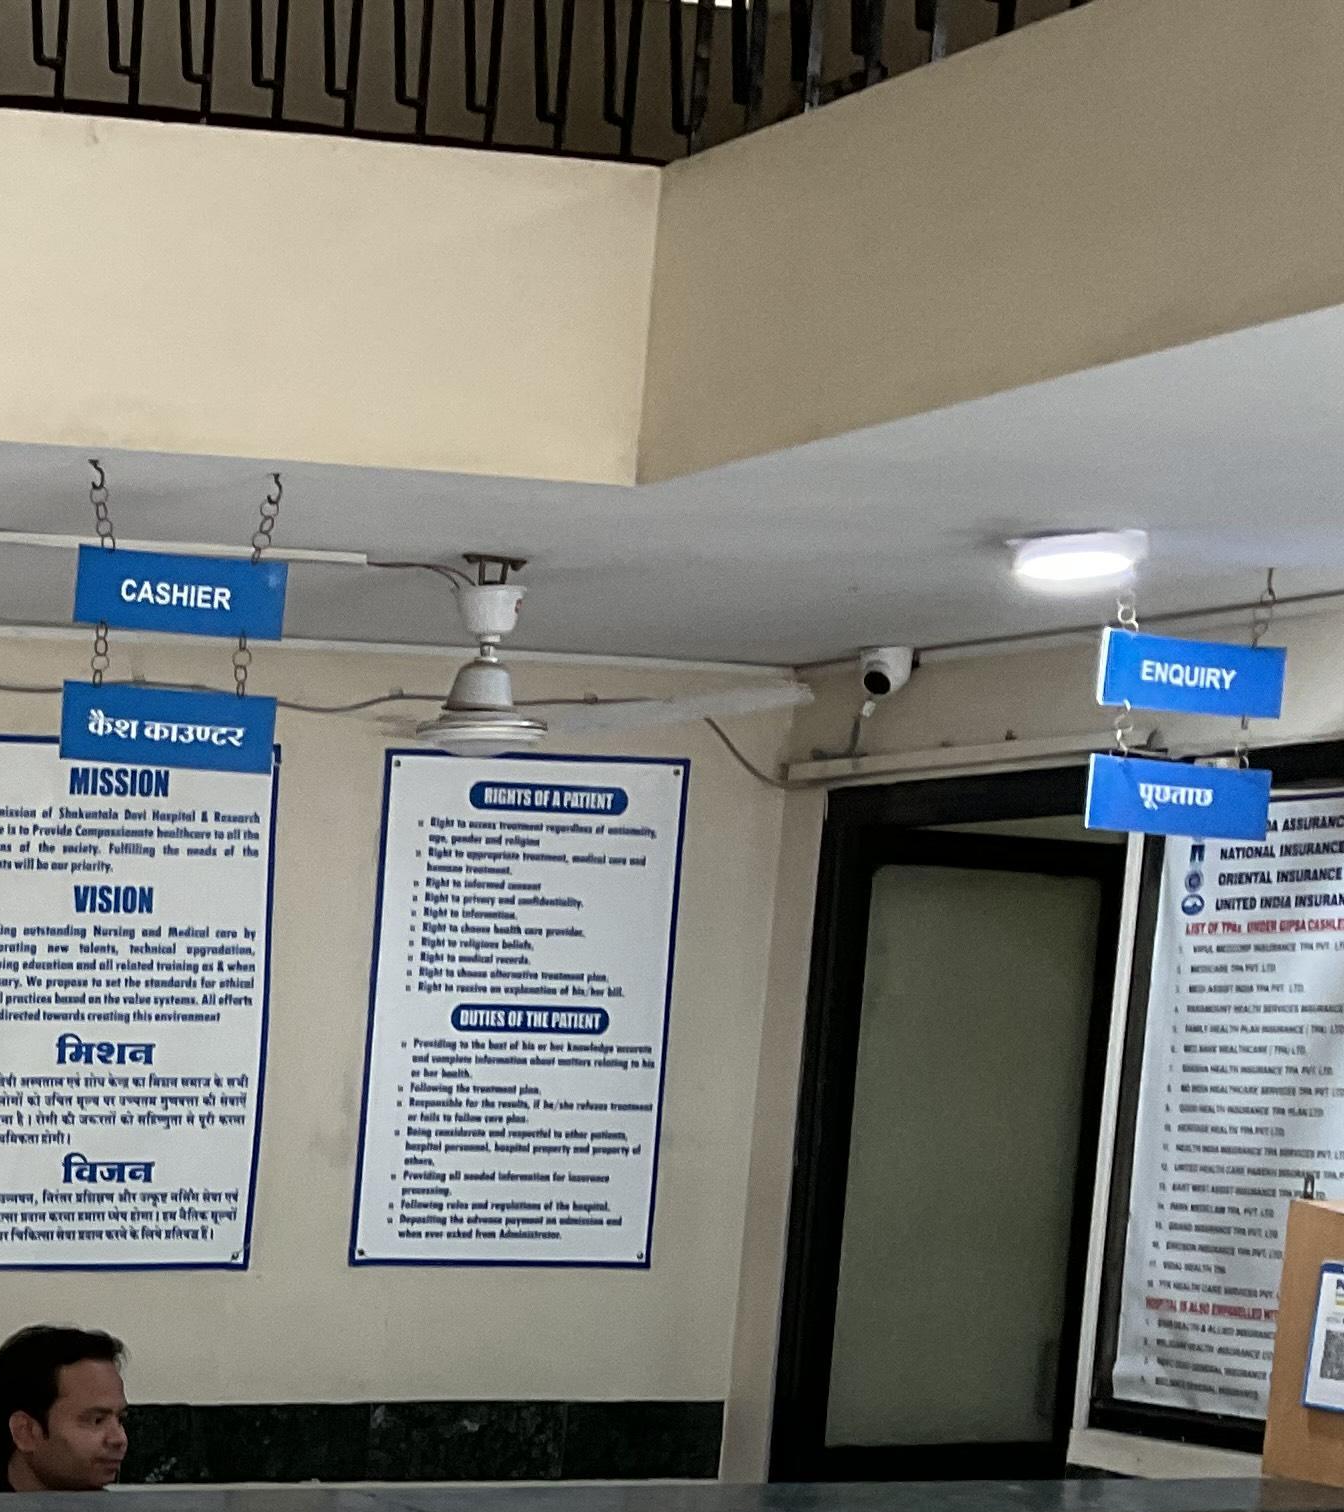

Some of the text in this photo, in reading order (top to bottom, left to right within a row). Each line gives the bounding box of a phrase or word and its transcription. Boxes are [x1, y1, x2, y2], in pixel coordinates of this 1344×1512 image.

[122, 579, 230, 610] CASHIER
[1142, 660, 1236, 689] ENQUIRY
[89, 710, 244, 746] कैश काउण्टर
[69, 767, 169, 797] MISSION
[485, 788, 613, 809] RIGHTS OF A PATIENT
[42, 806, 52, 818] of
[59, 807, 118, 820] Shakuntala
[125, 809, 146, 820] Devi
[152, 810, 195, 824] Hospital
[201, 811, 208, 822] &
[214, 811, 260, 823] Research
[1220, 840, 1344, 860] NATIONAL INSURANCE
[14, 858, 34, 870] will
[37, 858, 48, 870] be
[51, 862, 68, 870] our
[1218, 867, 1342, 886] ORIENTAL INSURANCE
[74, 885, 153, 913] VISION
[1216, 897, 1256, 911] UNITED
[1260, 896, 1291, 909] INDIA
[460, 1010, 601, 1029] DUTIES OF THE PATIENT
[56, 1033, 156, 1065] मिशन
[62, 1152, 155, 1183] विजन
